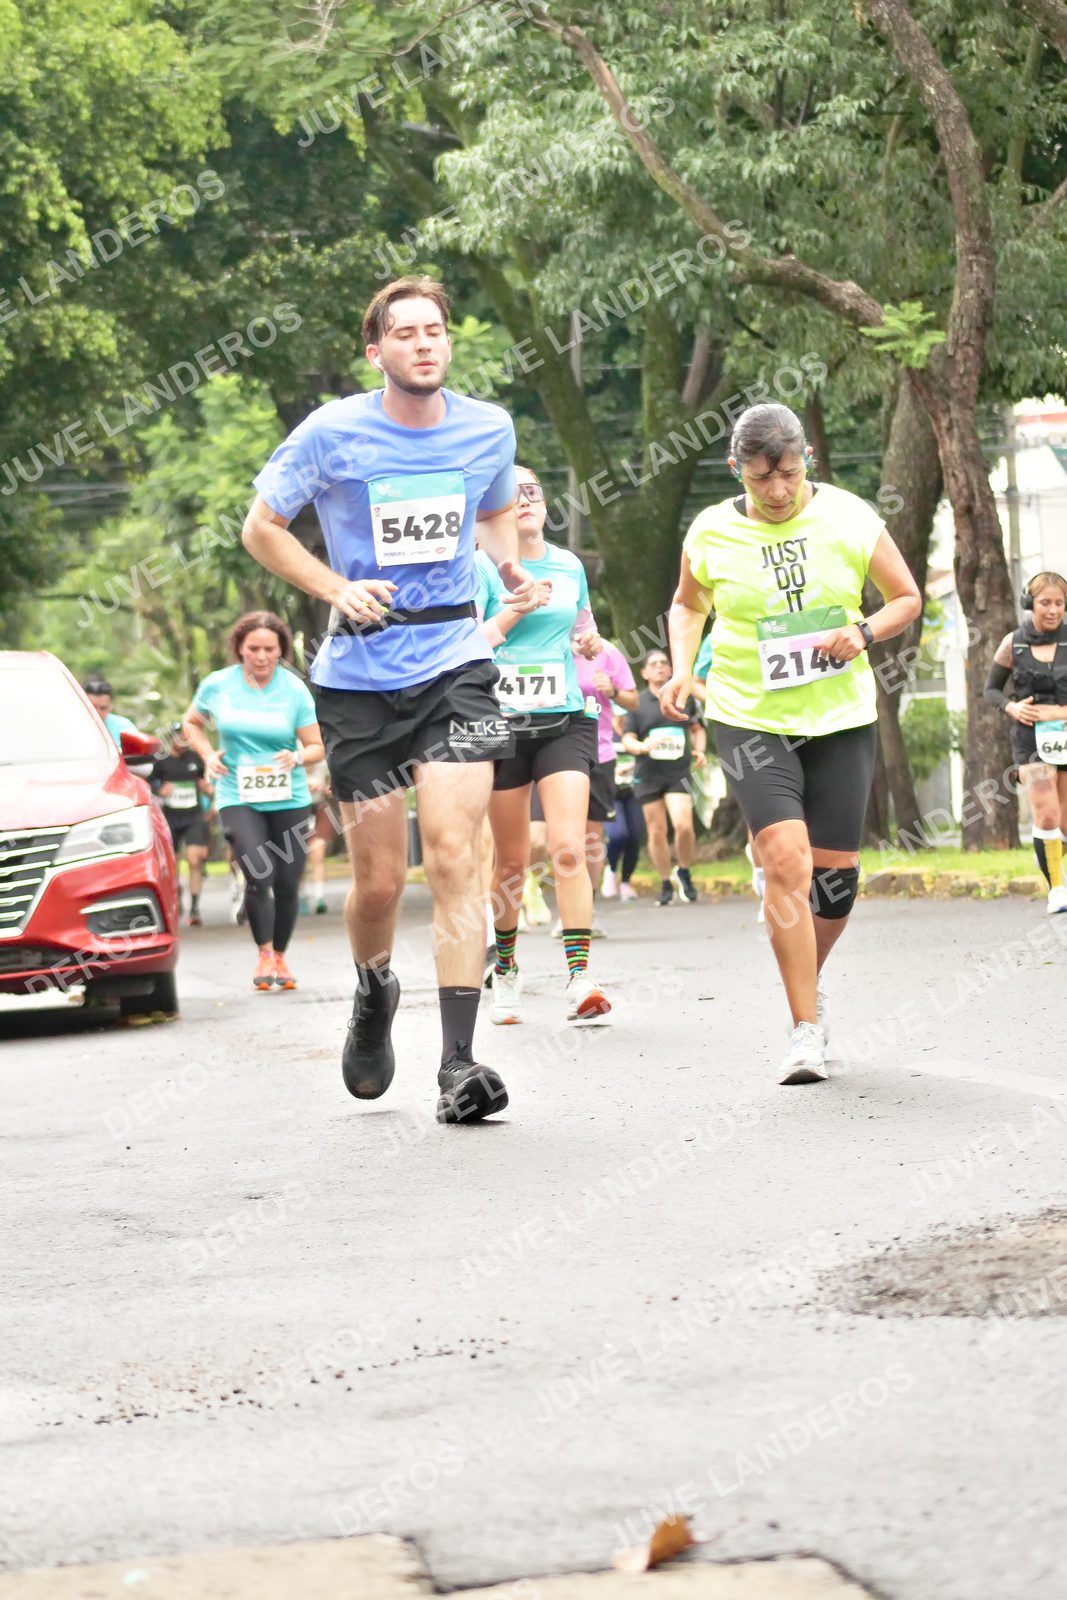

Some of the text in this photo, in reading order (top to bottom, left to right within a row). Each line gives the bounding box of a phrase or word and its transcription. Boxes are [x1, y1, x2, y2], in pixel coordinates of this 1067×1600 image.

[381, 511, 462, 544] 5428
[761, 537, 807, 569] JUST
[774, 562, 806, 590] DO
[786, 588, 804, 613] IT
[498, 675, 556, 695] 4171
[449, 719, 510, 736] NIKE
[242, 773, 288, 790] 2822
